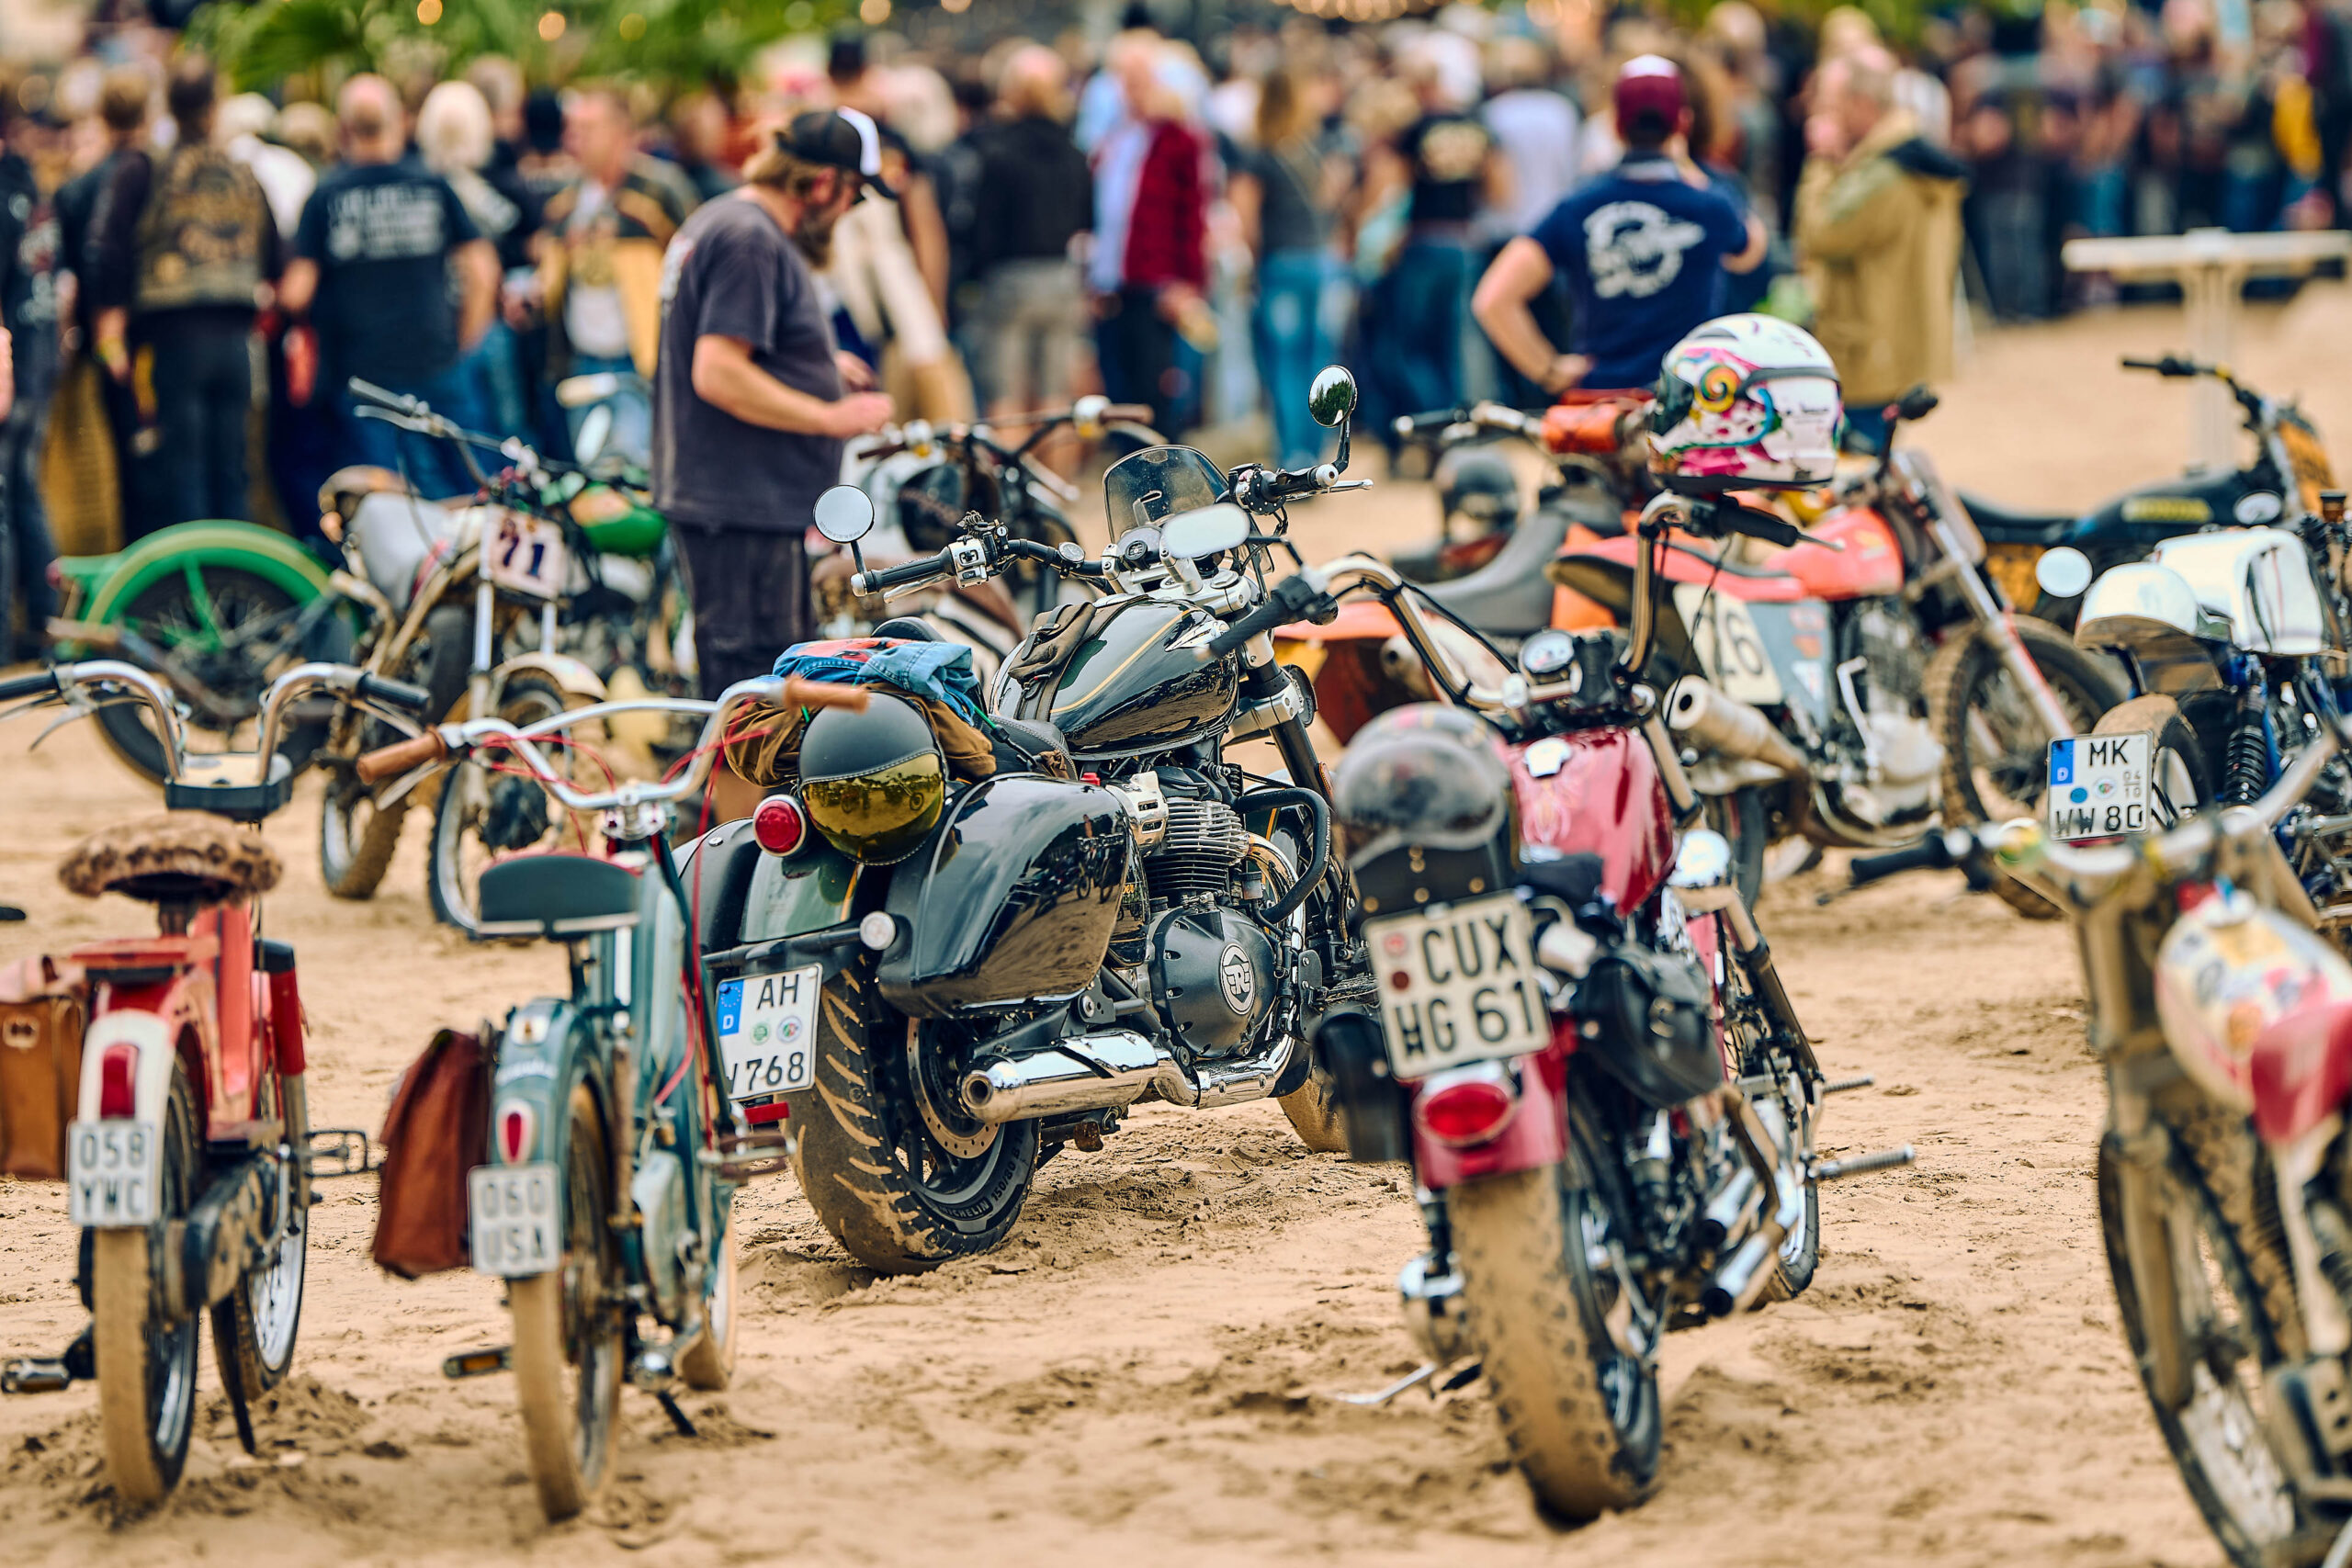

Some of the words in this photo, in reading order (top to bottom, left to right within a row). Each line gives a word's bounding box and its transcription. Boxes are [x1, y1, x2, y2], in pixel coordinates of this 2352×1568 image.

[2089, 739, 2129, 767] MK
[2057, 767, 2069, 782] D
[2055, 807, 2095, 837] WW
[1421, 914, 1519, 985] CUX
[757, 974, 799, 1010] AH
[722, 1014, 734, 1031] D
[1395, 998, 1456, 1057] HG
[1472, 980, 1534, 1043] 61
[79, 1131, 146, 1170] 058
